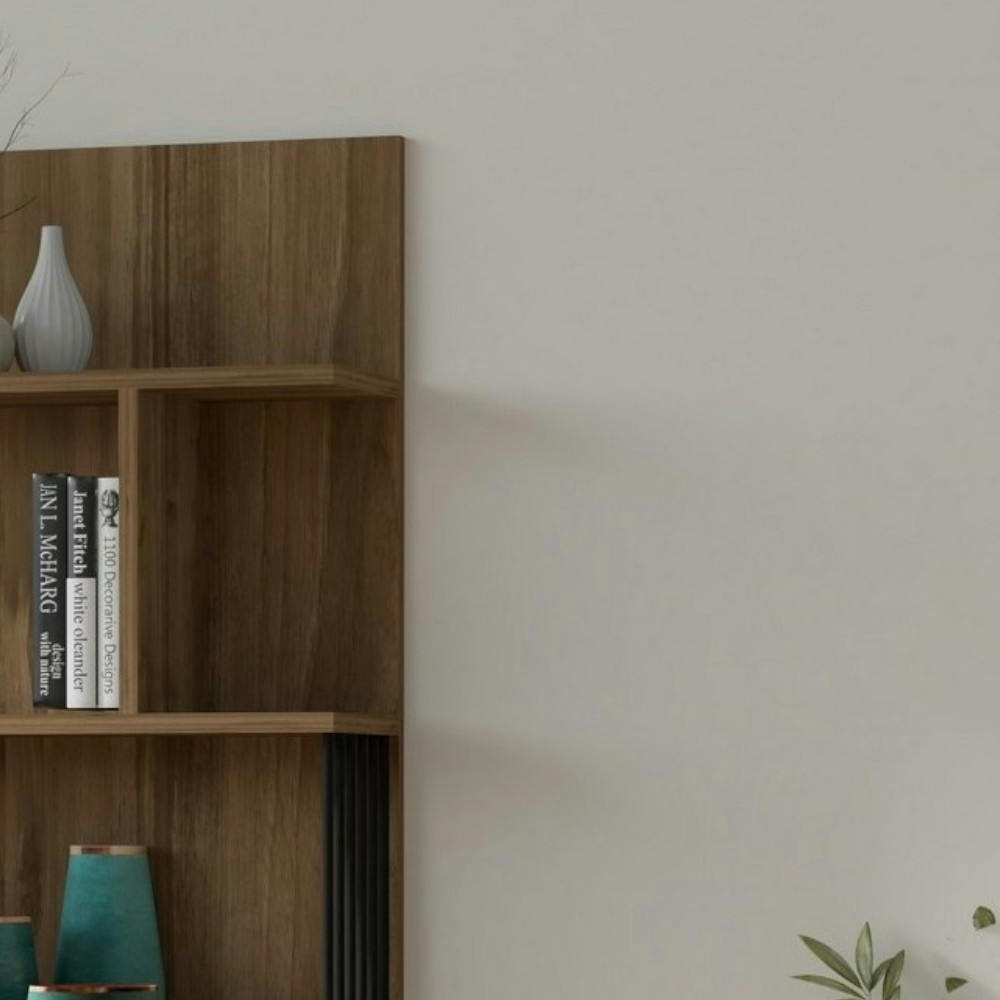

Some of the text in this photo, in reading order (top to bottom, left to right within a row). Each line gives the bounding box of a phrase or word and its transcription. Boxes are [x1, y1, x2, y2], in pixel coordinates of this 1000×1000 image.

[39, 515, 57, 530] L.
[73, 490, 87, 574] Janet Fitch
[104, 536, 117, 567] 1100
[39, 534, 58, 614] McHARG
[40, 631, 52, 697] with nature
[52, 643, 65, 680] design
[73, 583, 88, 693] white oleander
[101, 644, 117, 694] Designs
